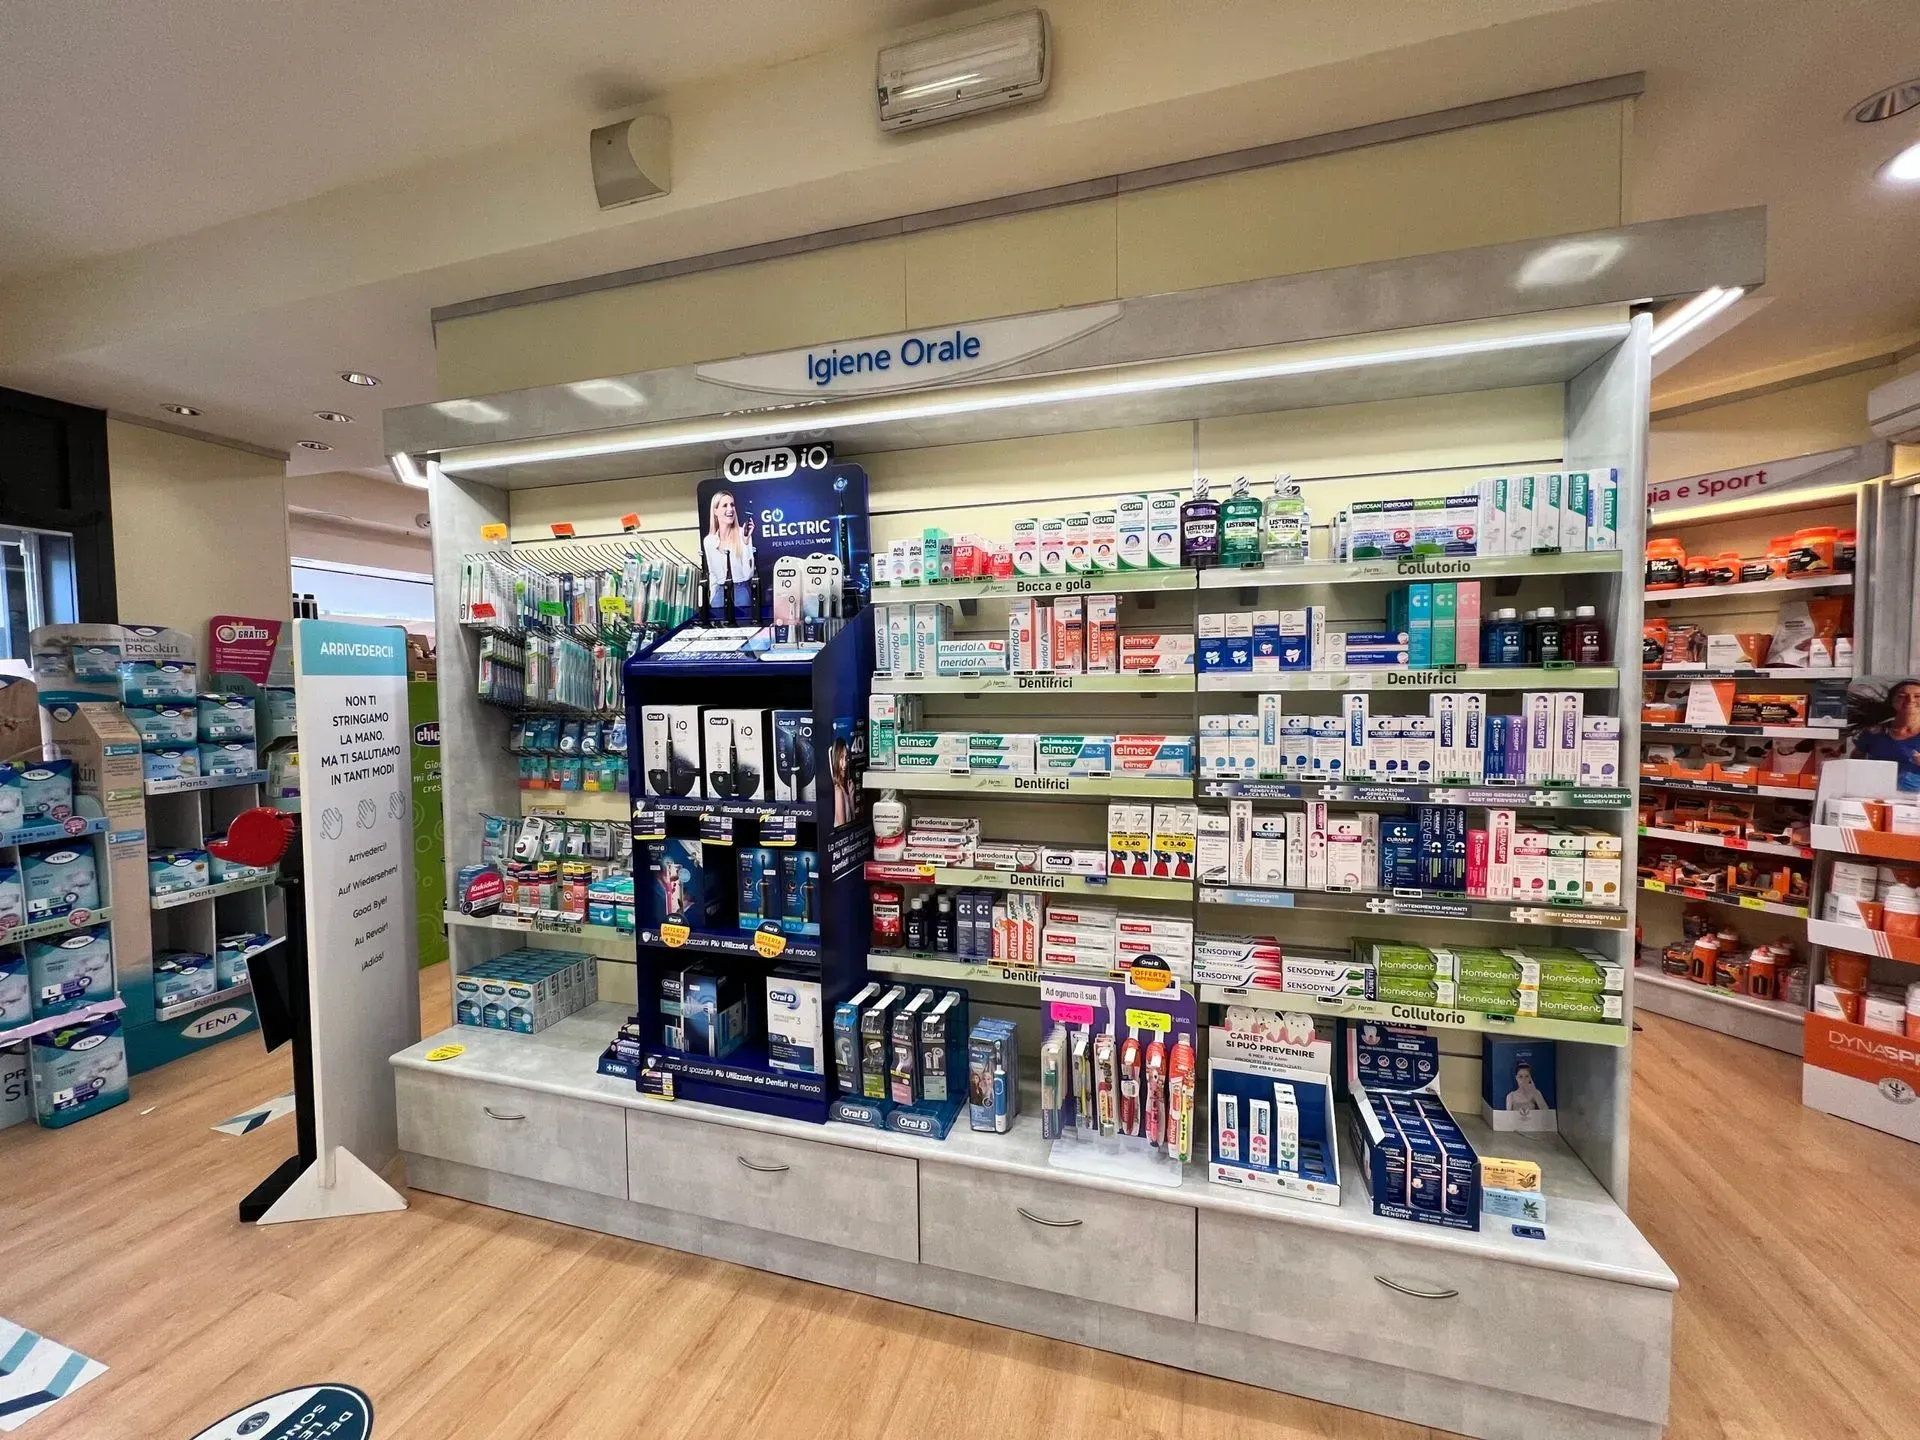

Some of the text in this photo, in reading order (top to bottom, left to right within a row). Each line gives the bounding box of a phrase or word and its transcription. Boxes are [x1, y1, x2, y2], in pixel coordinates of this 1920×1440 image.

[808, 331, 981, 385] Igiene Orale
[729, 446, 828, 476] Oral-B iO
[1677, 485, 1690, 497] e
[1698, 470, 1768, 497] Sport
[1575, 475, 1584, 509] elmex
[1353, 503, 1381, 511] DENTOSAN
[1383, 501, 1413, 509] DENTOSAN
[1414, 499, 1444, 507] DENTOSAN
[1446, 497, 1477, 505] DENTOSAN
[761, 508, 784, 523] GO
[762, 519, 831, 538] ELECTRIC
[1226, 521, 1256, 529] LISTERINE
[1397, 560, 1471, 575] Collutorio
[1017, 581, 1051, 593] Bocca
[1055, 582, 1062, 591] e
[1066, 578, 1091, 592] gola
[238, 630, 268, 640] GRATIS
[940, 642, 977, 653] meridol
[1057, 625, 1065, 660] elmex
[1091, 626, 1099, 661] elmex
[1124, 637, 1154, 646] elmex
[320, 641, 394, 658] ARRIVEDERCI!
[940, 657, 977, 668] meridol
[1124, 656, 1154, 665] elmex
[1018, 677, 1073, 689] Dentifrici
[1388, 672, 1457, 685] Dentifrici
[345, 695, 376, 707] NON TI
[332, 711, 389, 727] STRINGIAMO
[340, 730, 385, 745] LA MANO.
[417, 727, 440, 742] chic
[900, 737, 931, 747] elmex
[970, 737, 998, 746] elmex
[321, 745, 401, 768] MA TI SALUTIAMO
[900, 756, 932, 765] elmex
[331, 763, 395, 786] IN TANTI MODI
[180, 780, 208, 788] Pants
[1015, 777, 1069, 790] Dentifrici
[915, 819, 949, 827] parodontax
[1423, 808, 1432, 851] PREVENT
[1447, 808, 1456, 851] PREVENT
[911, 835, 946, 843] parodontax
[976, 852, 1014, 861] parodontax
[1047, 857, 1070, 865] Oral-B
[1384, 846, 1393, 889] PREVENT
[1011, 873, 1065, 889] Dentifrici
[188, 888, 216, 899] Pants
[338, 885, 351, 897] Auf
[352, 904, 372, 919] Good
[1122, 924, 1150, 932] tau-marin
[354, 933, 365, 947] Au
[1198, 947, 1243, 957] SENSODYNE
[1287, 966, 1336, 977] SENSODYNE
[1380, 961, 1435, 971] Homéodent
[1003, 968, 1042, 983] Dentif
[1197, 971, 1243, 981] SENSODYNE
[1461, 968, 1520, 980] Homéodent
[1541, 973, 1603, 985] Homéodent
[1045, 986, 1054, 995] Ad
[1287, 981, 1336, 992] SENSODYNE
[770, 993, 794, 1002] Oral-B
[1391, 1004, 1466, 1025] Collutorio
[194, 1012, 239, 1035] TENA
[78, 1038, 101, 1049] TENA
[1230, 1032, 1264, 1043] CARIE?
[1226, 1040, 1315, 1059] SI PUÒ PREVENIRE
[4, 1068, 27, 1084] PR
[800, 1082, 821, 1093] mondo
[842, 1108, 869, 1120] Oral-B
[900, 1117, 928, 1129] Oral-B
[278, 1404, 326, 1440] SON
[318, 1411, 353, 1440] DEL
[300, 1422, 323, 1440] LE
